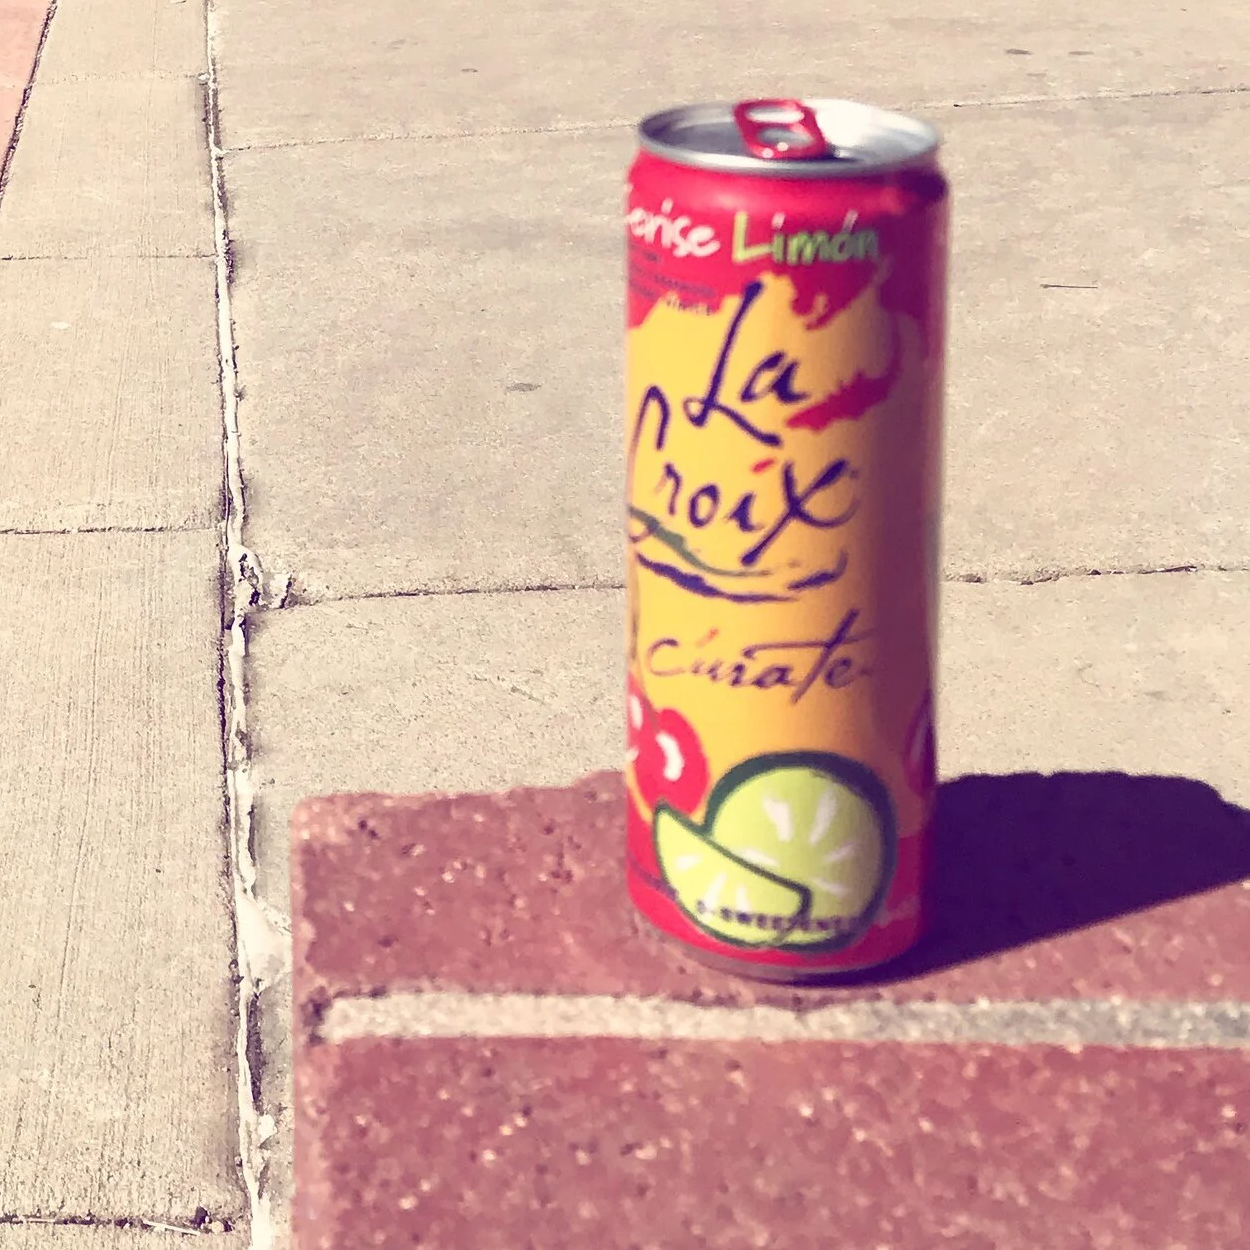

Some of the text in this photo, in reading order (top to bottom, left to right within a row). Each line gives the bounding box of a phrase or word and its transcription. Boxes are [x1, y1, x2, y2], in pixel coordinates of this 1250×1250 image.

[628, 199, 878, 264] erise Limón
[683, 280, 810, 448] La
